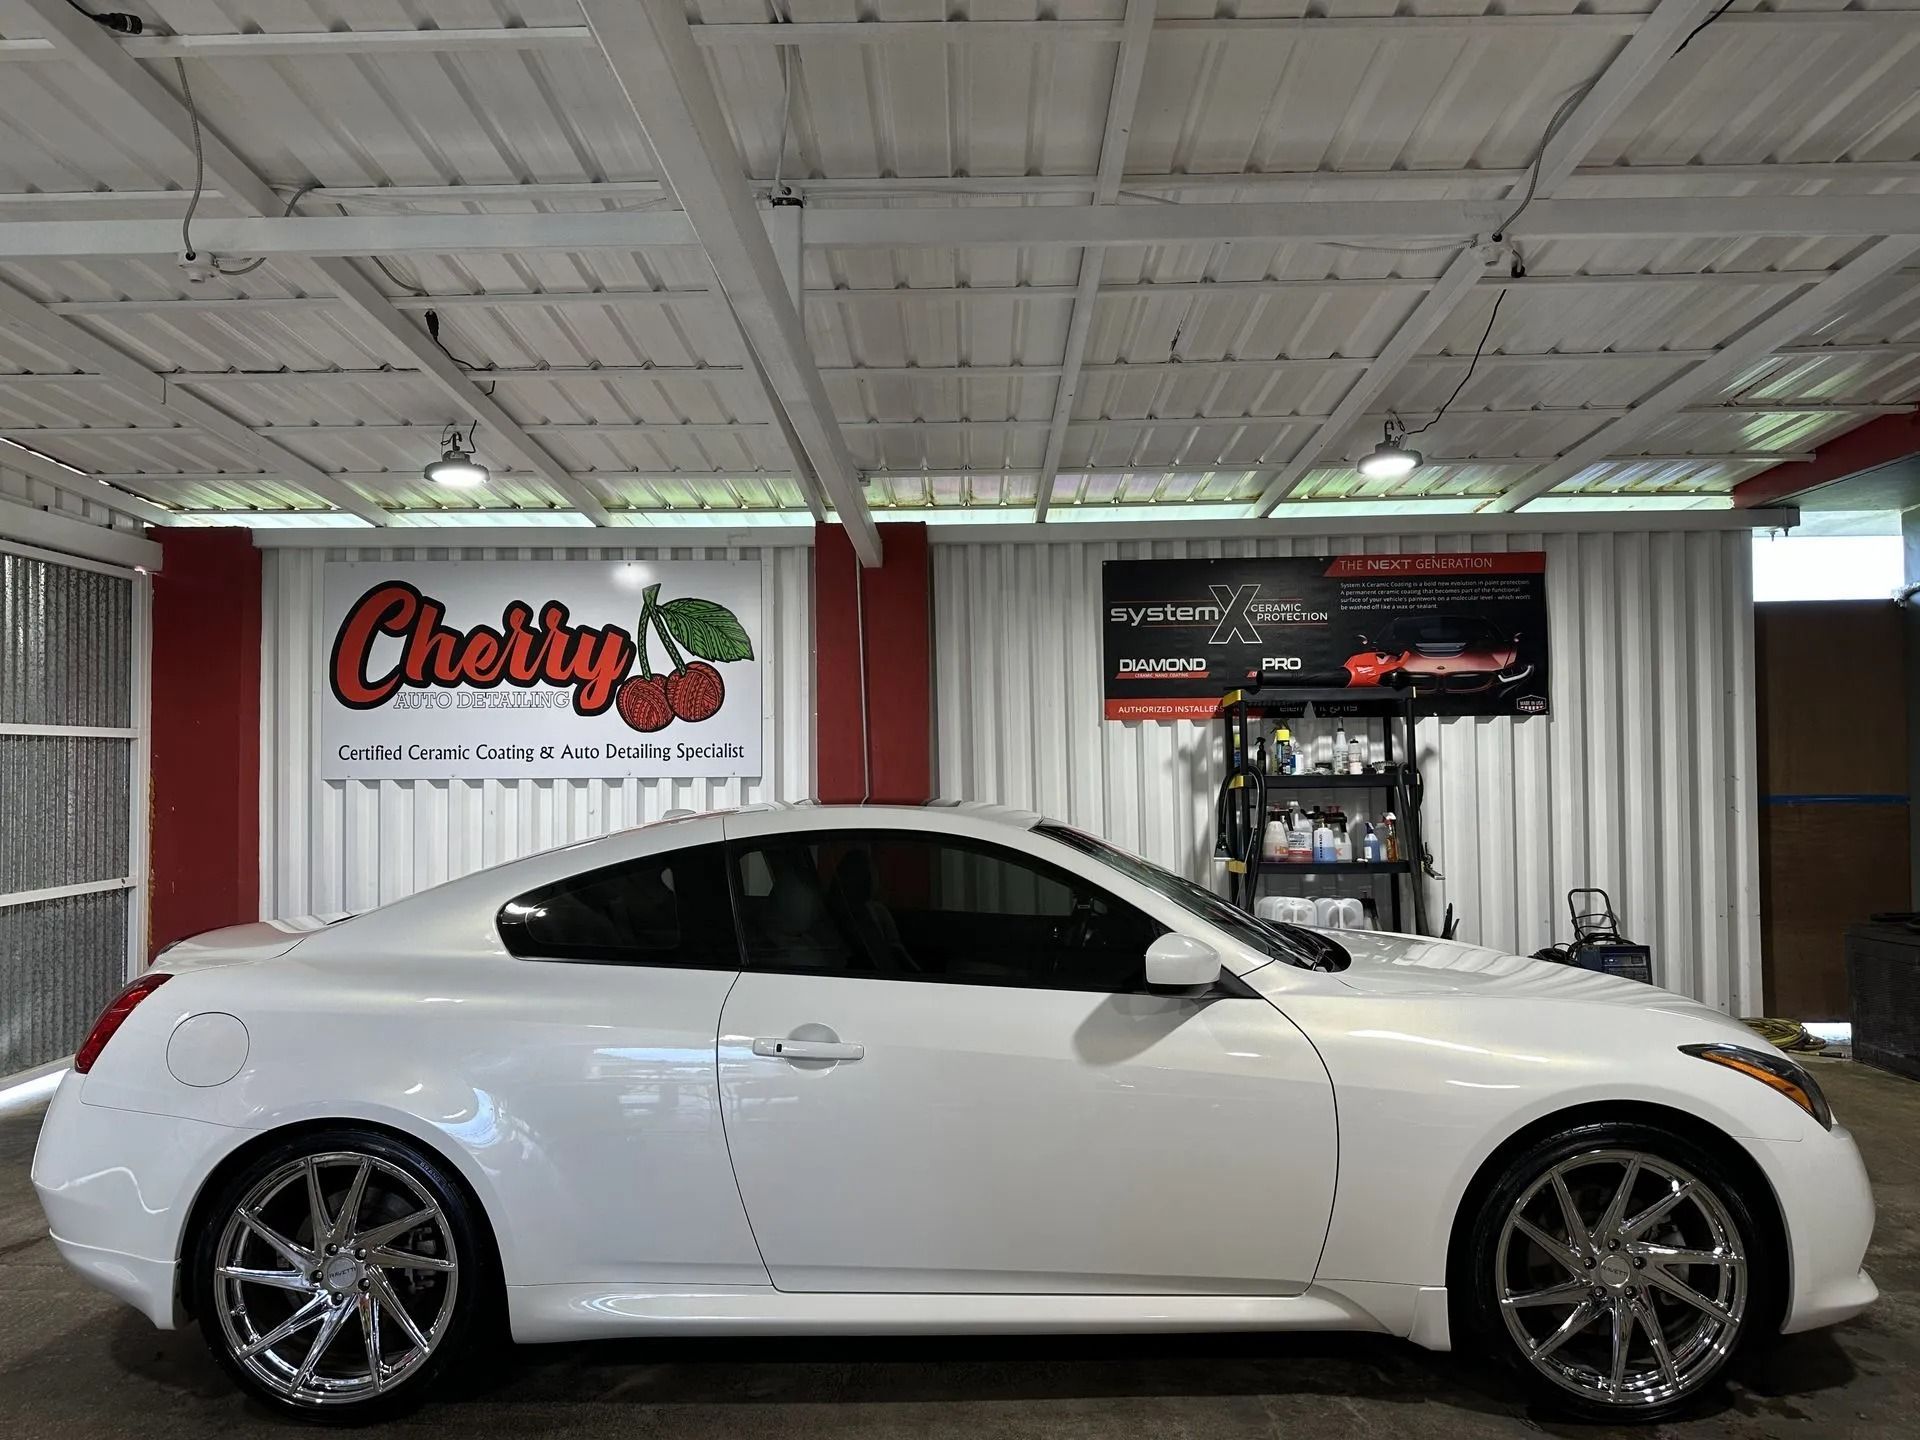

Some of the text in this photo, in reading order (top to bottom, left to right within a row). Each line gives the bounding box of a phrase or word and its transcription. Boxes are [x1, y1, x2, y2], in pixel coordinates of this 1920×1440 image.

[1339, 557, 1493, 571] THE NEXT GENERATION
[1345, 589, 1377, 597] permanent
[1110, 583, 1263, 644] system X
[1250, 603, 1302, 613] CERAMIC
[1256, 612, 1328, 622] PROTECTION
[329, 580, 636, 717] Cherry
[1119, 657, 1302, 672] DIAMOND PRO
[393, 691, 571, 709] AUTO DETAILING
[1118, 705, 1173, 714] AUTHORIZED
[338, 742, 745, 763] Certified Ceramic Coating & Auto Detailing Specialist
